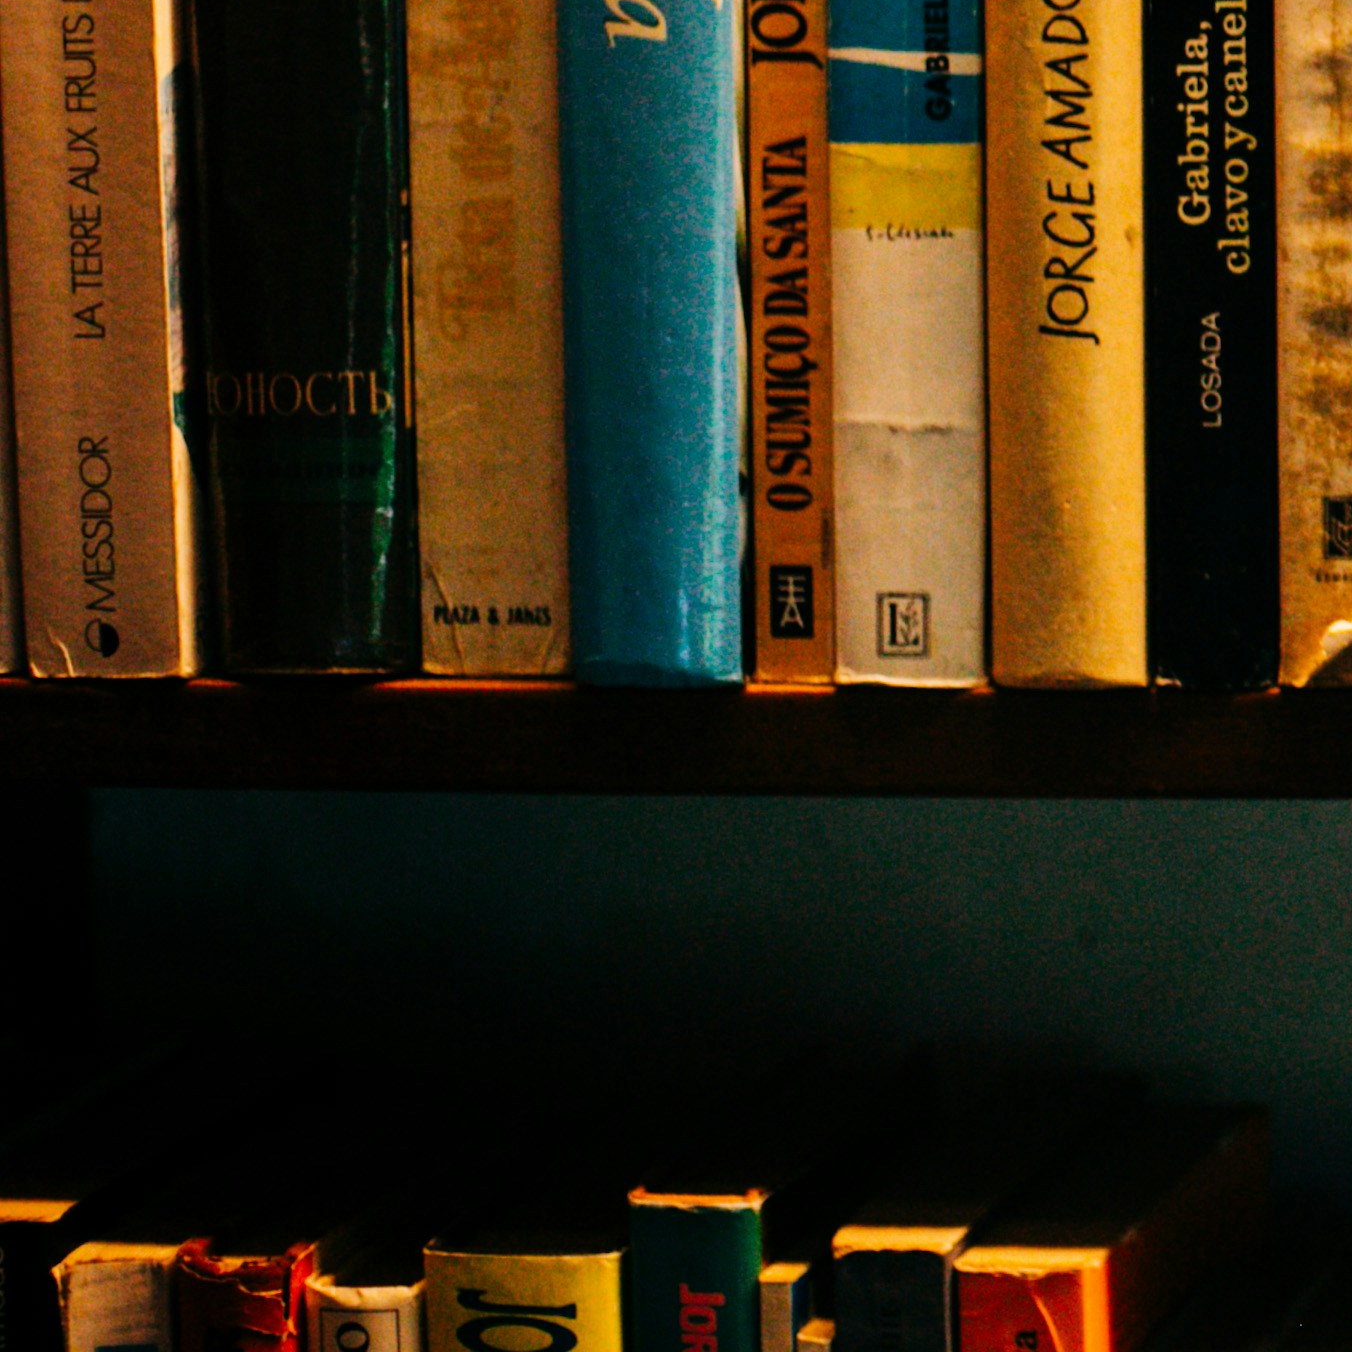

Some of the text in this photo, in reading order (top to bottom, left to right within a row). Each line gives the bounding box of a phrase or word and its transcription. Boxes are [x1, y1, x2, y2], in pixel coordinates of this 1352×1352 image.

[63, 15, 98, 113] FRUITS
[67, 126, 101, 196] AUX
[1177, 20, 1214, 226] Gabriela,
[1221, 122, 1258, 152] y
[69, 204, 103, 299] TERRE
[1039, 180, 1101, 346] JORGE
[1217, 158, 1251, 276] clavo
[75, 300, 106, 340] LA
[762, 135, 819, 512] O SUMIÇO DA SANTA
[1201, 311, 1223, 430] LOSADA
[206, 370, 394, 418] ЮНОСТЬ
[80, 434, 117, 614] MESSIDOR
